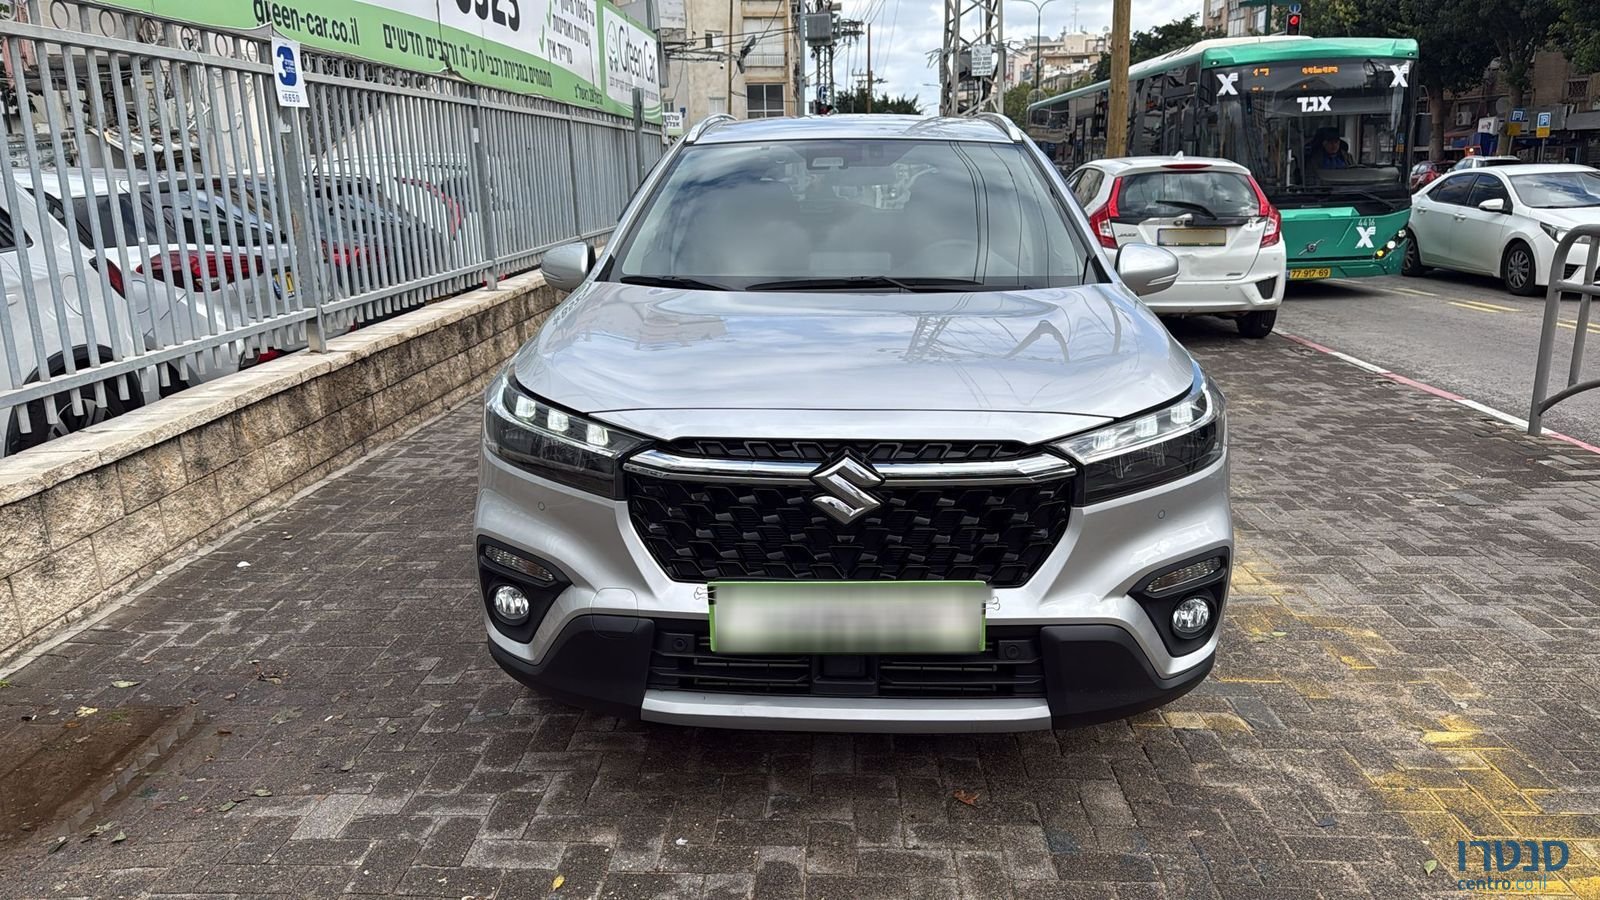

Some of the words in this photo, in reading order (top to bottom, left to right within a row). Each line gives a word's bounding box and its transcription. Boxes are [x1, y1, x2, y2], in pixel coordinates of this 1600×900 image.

[383, 23, 424, 57] חדשים
[618, 25, 645, 79] Green
[485, 54, 504, 77] רכבי
